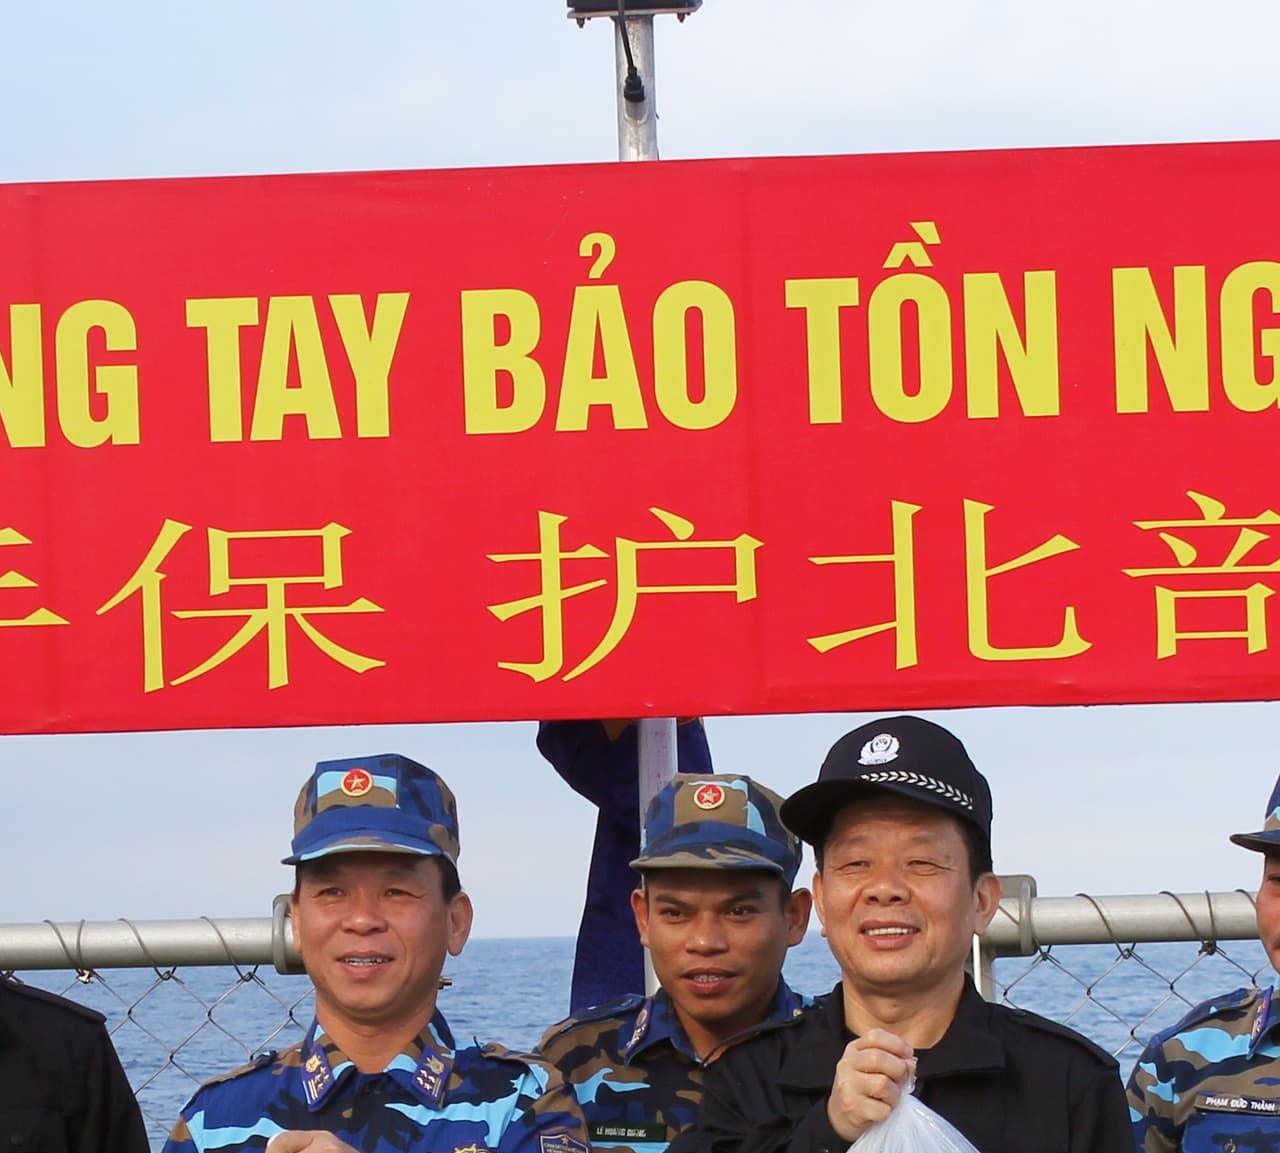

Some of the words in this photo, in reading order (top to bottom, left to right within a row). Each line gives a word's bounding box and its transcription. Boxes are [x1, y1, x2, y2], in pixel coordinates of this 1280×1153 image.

[185, 292, 410, 442] TAY
[460, 232, 738, 435] BẢO
[785, 221, 1060, 423] TỒN
